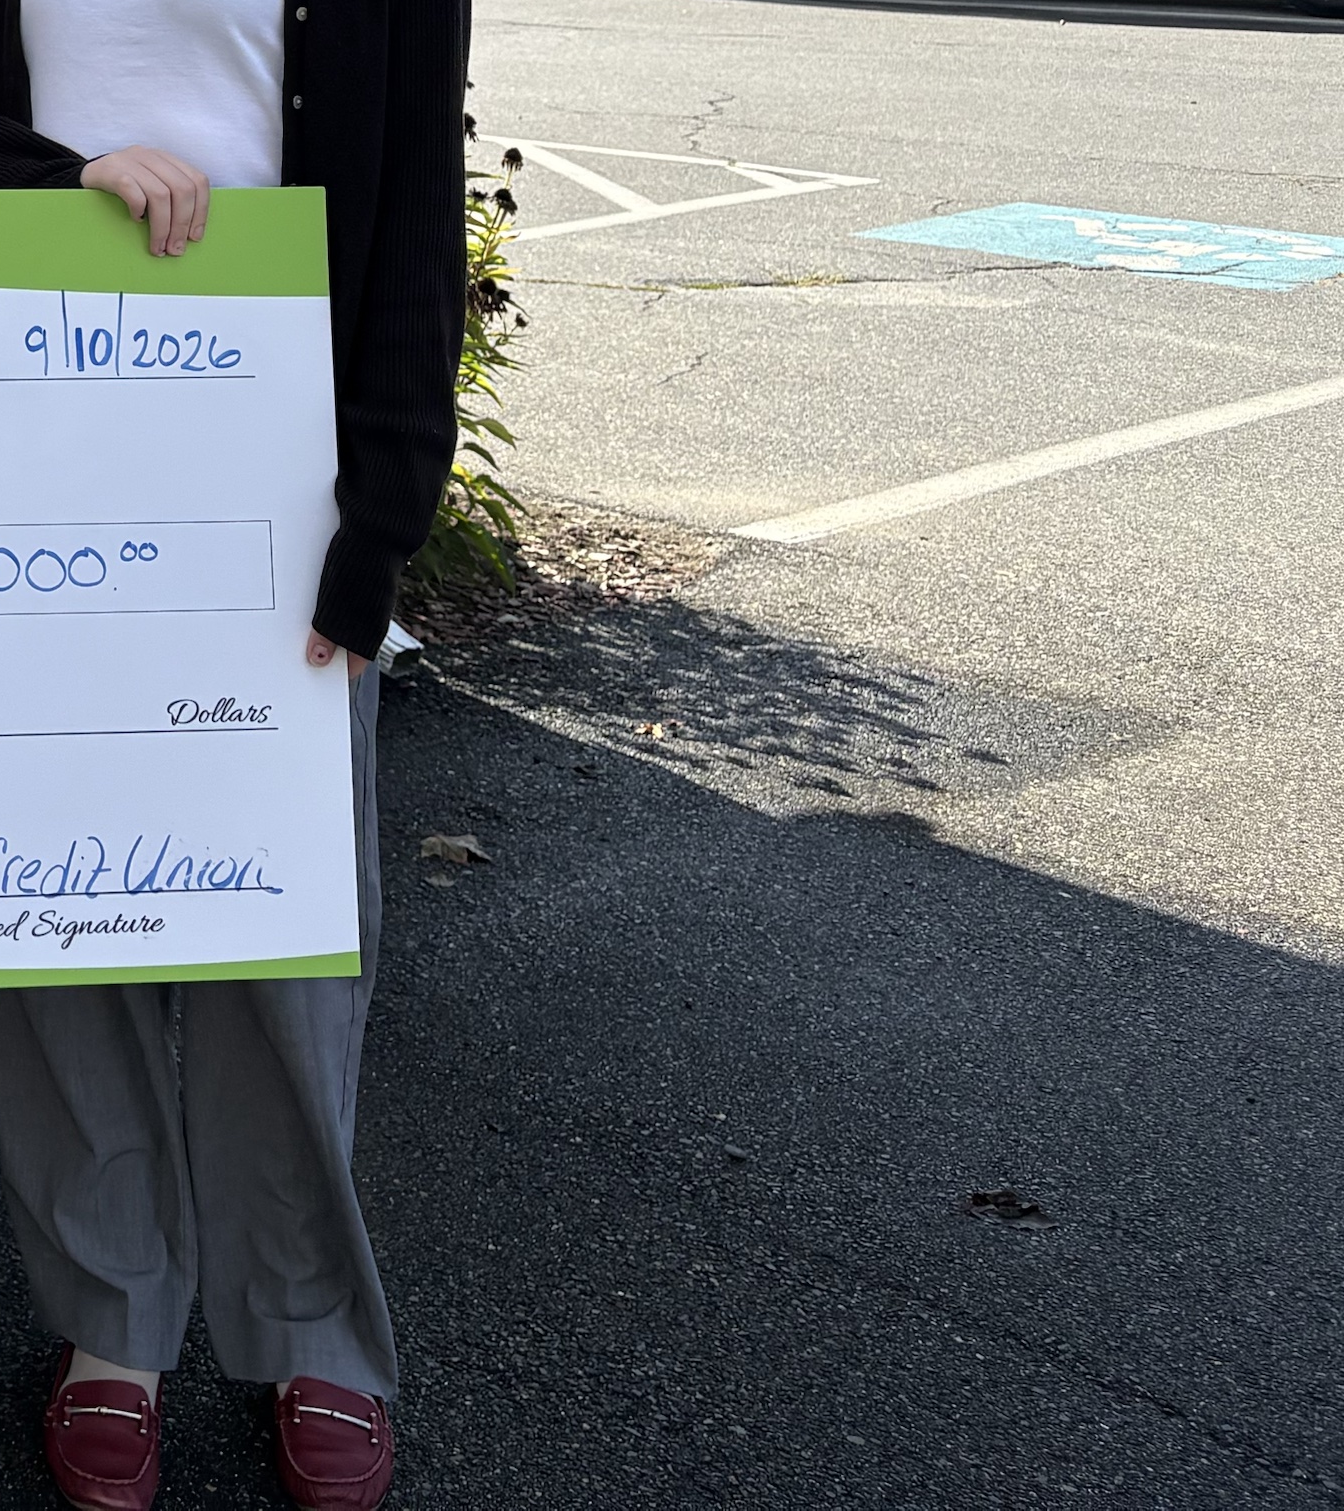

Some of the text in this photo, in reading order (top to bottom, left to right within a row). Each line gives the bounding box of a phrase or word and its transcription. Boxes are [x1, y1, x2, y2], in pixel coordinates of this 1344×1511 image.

[24, 290, 242, 376] 9/10/2026
[166, 697, 273, 726] Dollars
[122, 834, 285, 896] Union
[30, 908, 167, 951] Signature
